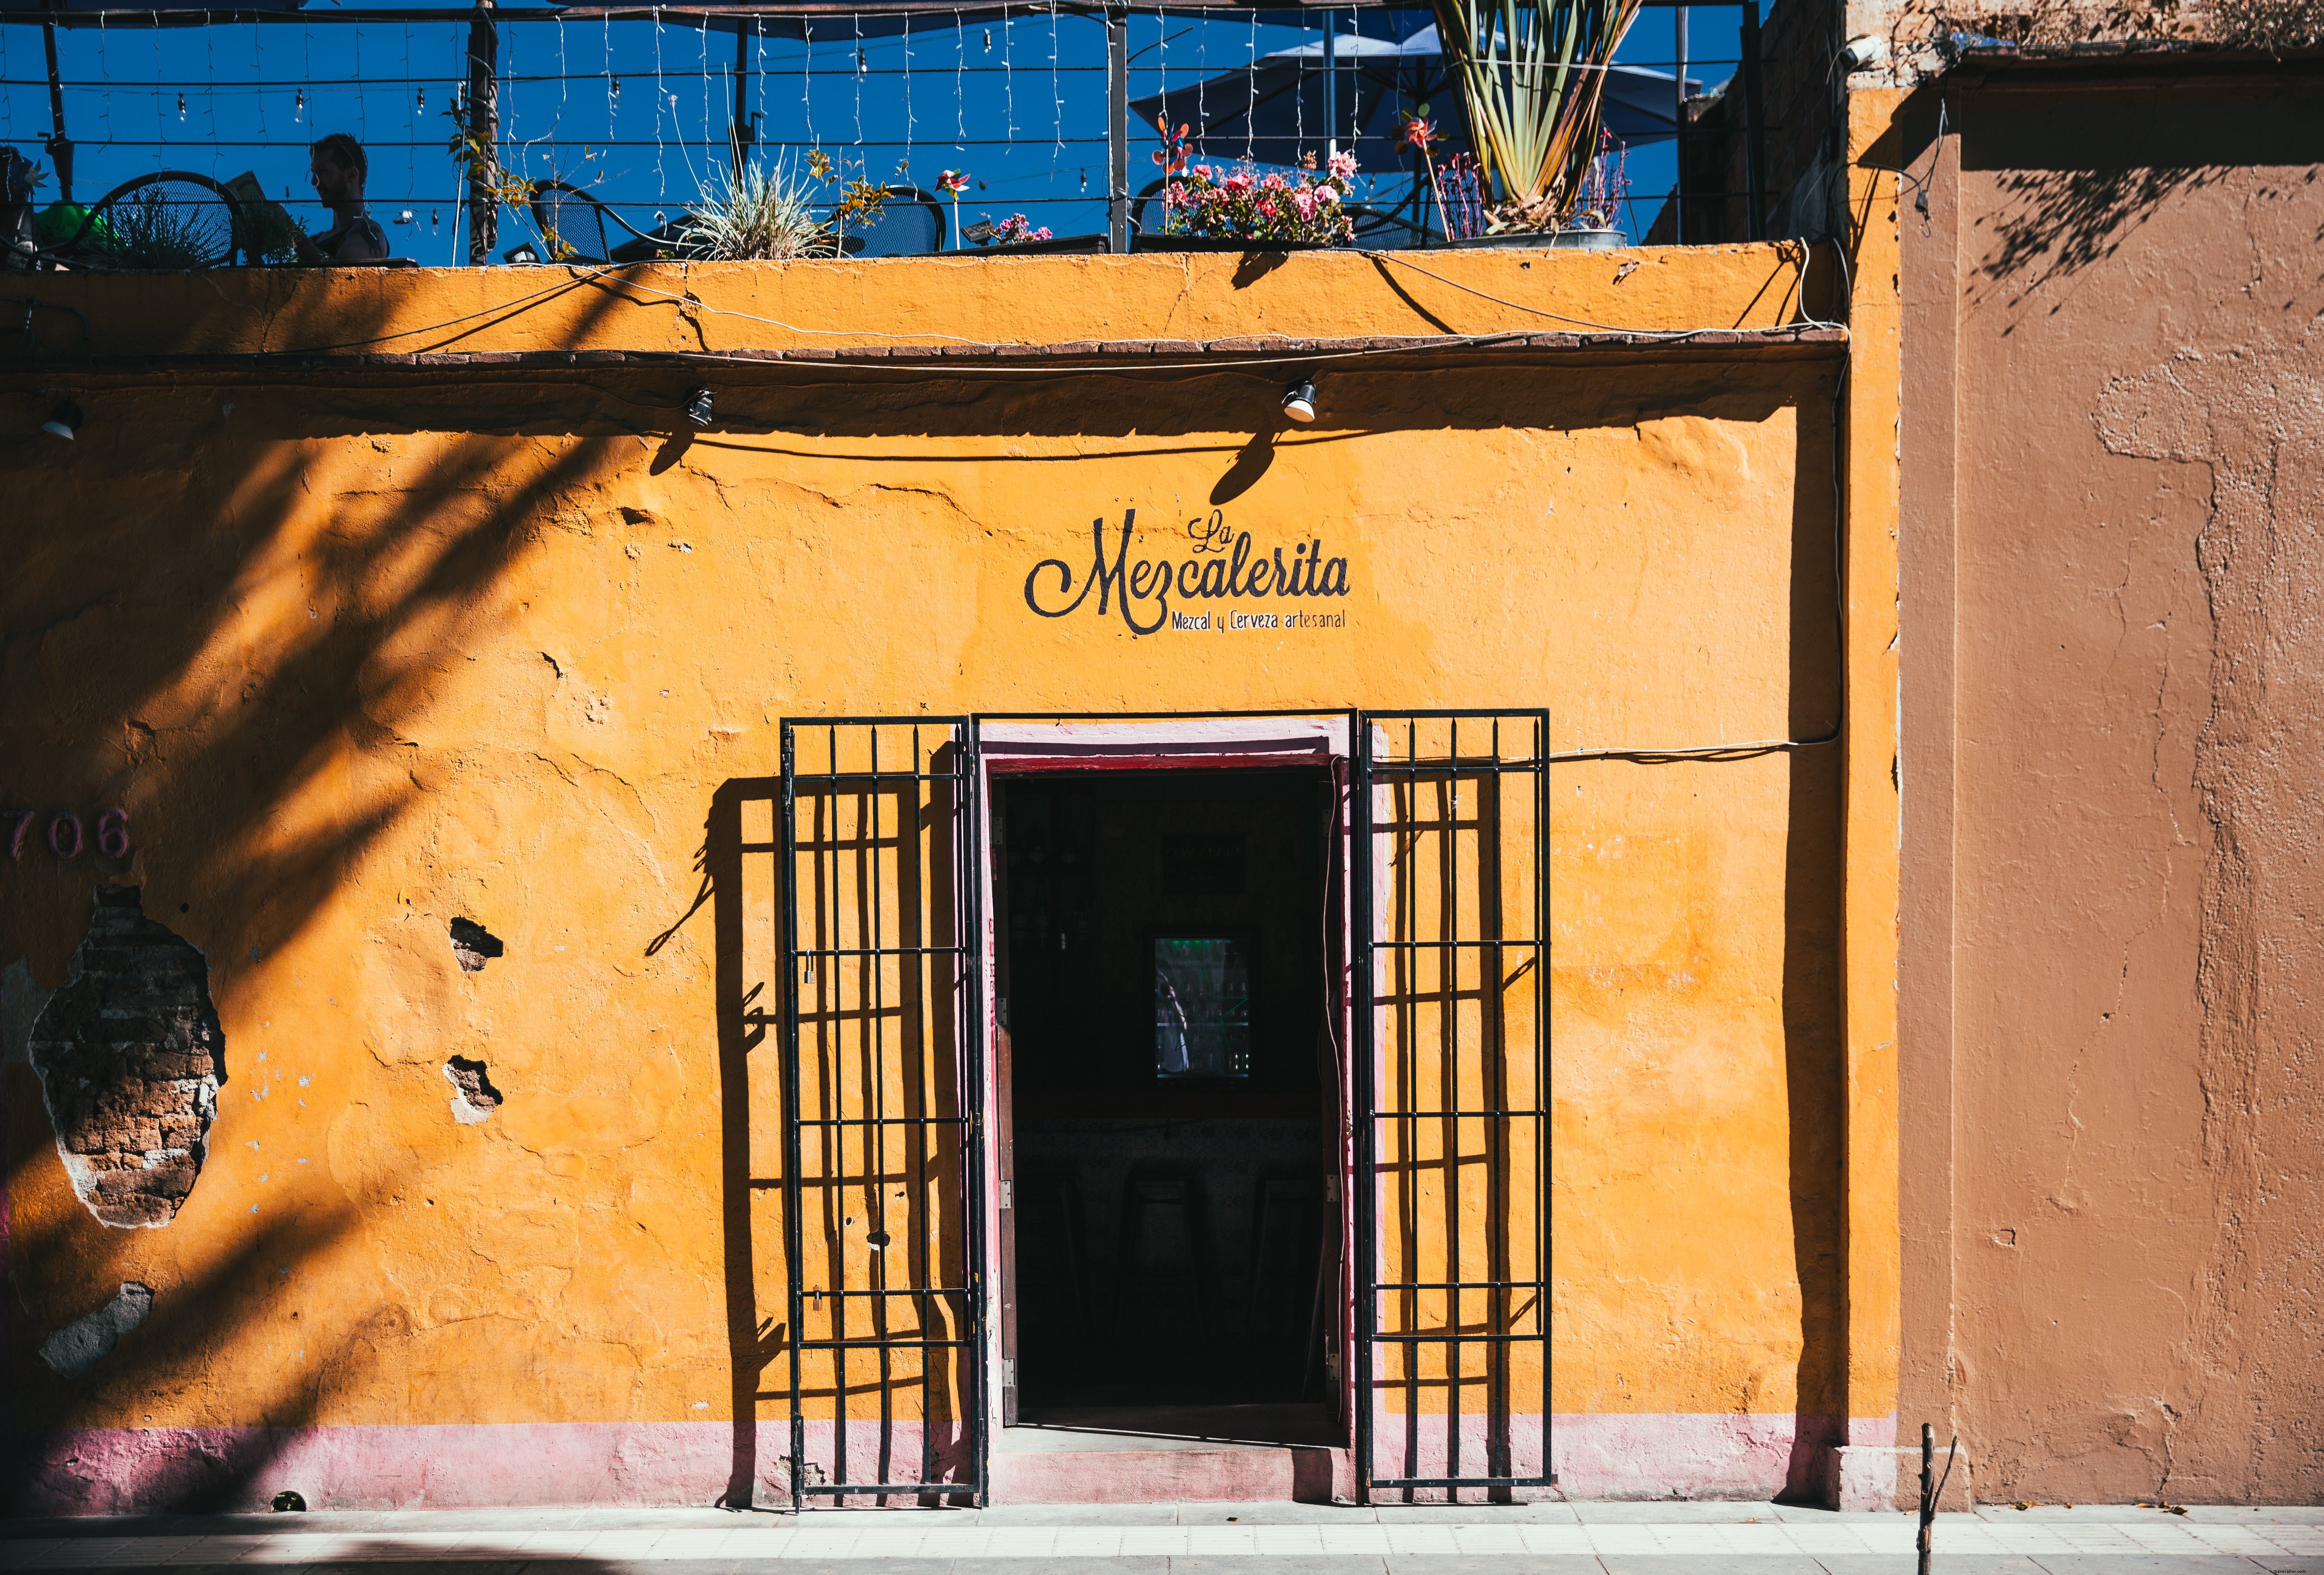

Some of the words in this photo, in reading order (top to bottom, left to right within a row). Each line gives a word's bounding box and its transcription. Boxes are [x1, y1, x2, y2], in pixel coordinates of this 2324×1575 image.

[1187, 509, 1235, 553] La
[1025, 509, 1350, 635] Mezcalerita
[1172, 610, 1210, 630] Mezcal
[1217, 615, 1224, 634] y
[1230, 610, 1278, 629] Cerveza
[1285, 610, 1345, 628] artesanal
[1, 808, 129, 859] 706
